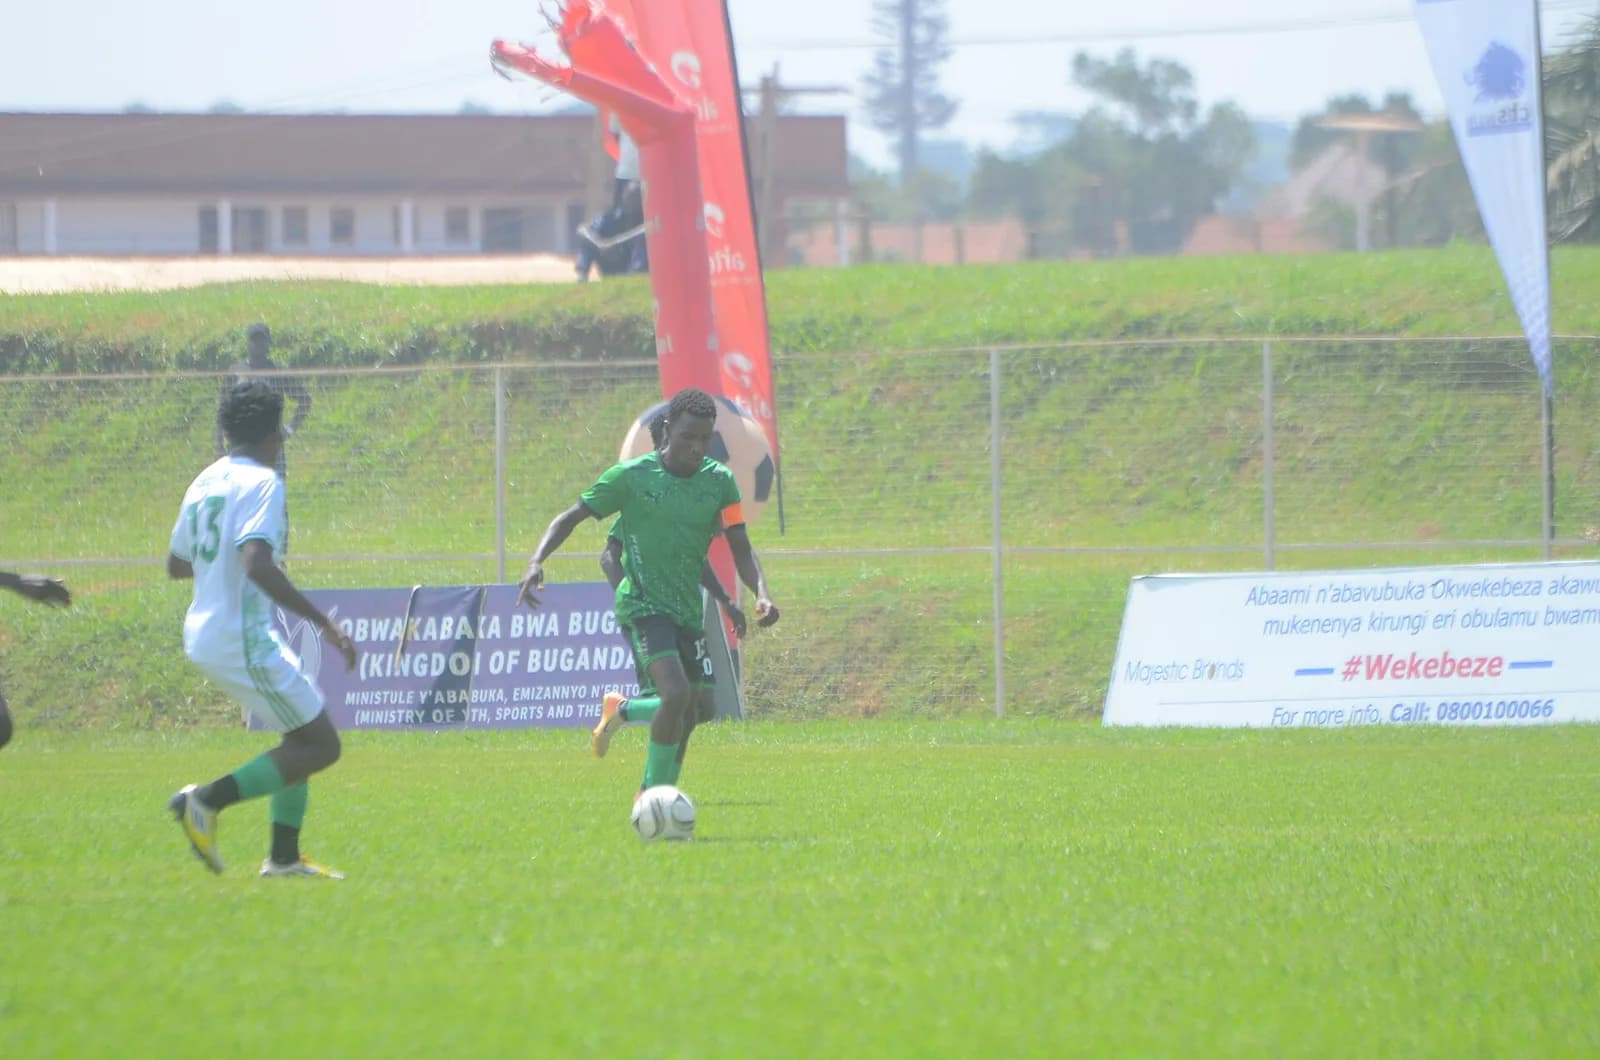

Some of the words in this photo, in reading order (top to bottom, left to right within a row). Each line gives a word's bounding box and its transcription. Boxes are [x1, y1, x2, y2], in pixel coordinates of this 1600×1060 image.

[1245, 583, 1312, 607] Abaami
[1315, 580, 1425, 604] n'abavubuka
[1430, 576, 1542, 600] Okwekebeza
[510, 612, 559, 639] BWA
[567, 610, 622, 637] BUG
[1263, 614, 1362, 638] mukenenya
[1367, 609, 1430, 636] kirungi
[1432, 608, 1457, 630] eri
[1460, 605, 1538, 629] obulamu
[488, 650, 521, 676] OF
[1123, 660, 1189, 687] Majestic
[1191, 658, 1245, 680] Brnds
[1342, 649, 1504, 682] #Wekebeze
[345, 689, 416, 706] MINISTULE
[512, 685, 588, 702] EMIZANNYO
[354, 708, 425, 727] (MINISTRY
[431, 708, 456, 723] OF
[495, 705, 543, 722] SPORTS
[547, 703, 573, 720] AND
[1270, 707, 1298, 727] For
[1302, 707, 1344, 725] more
[1389, 701, 1431, 723] Call:
[1436, 698, 1555, 722] 0800100066
